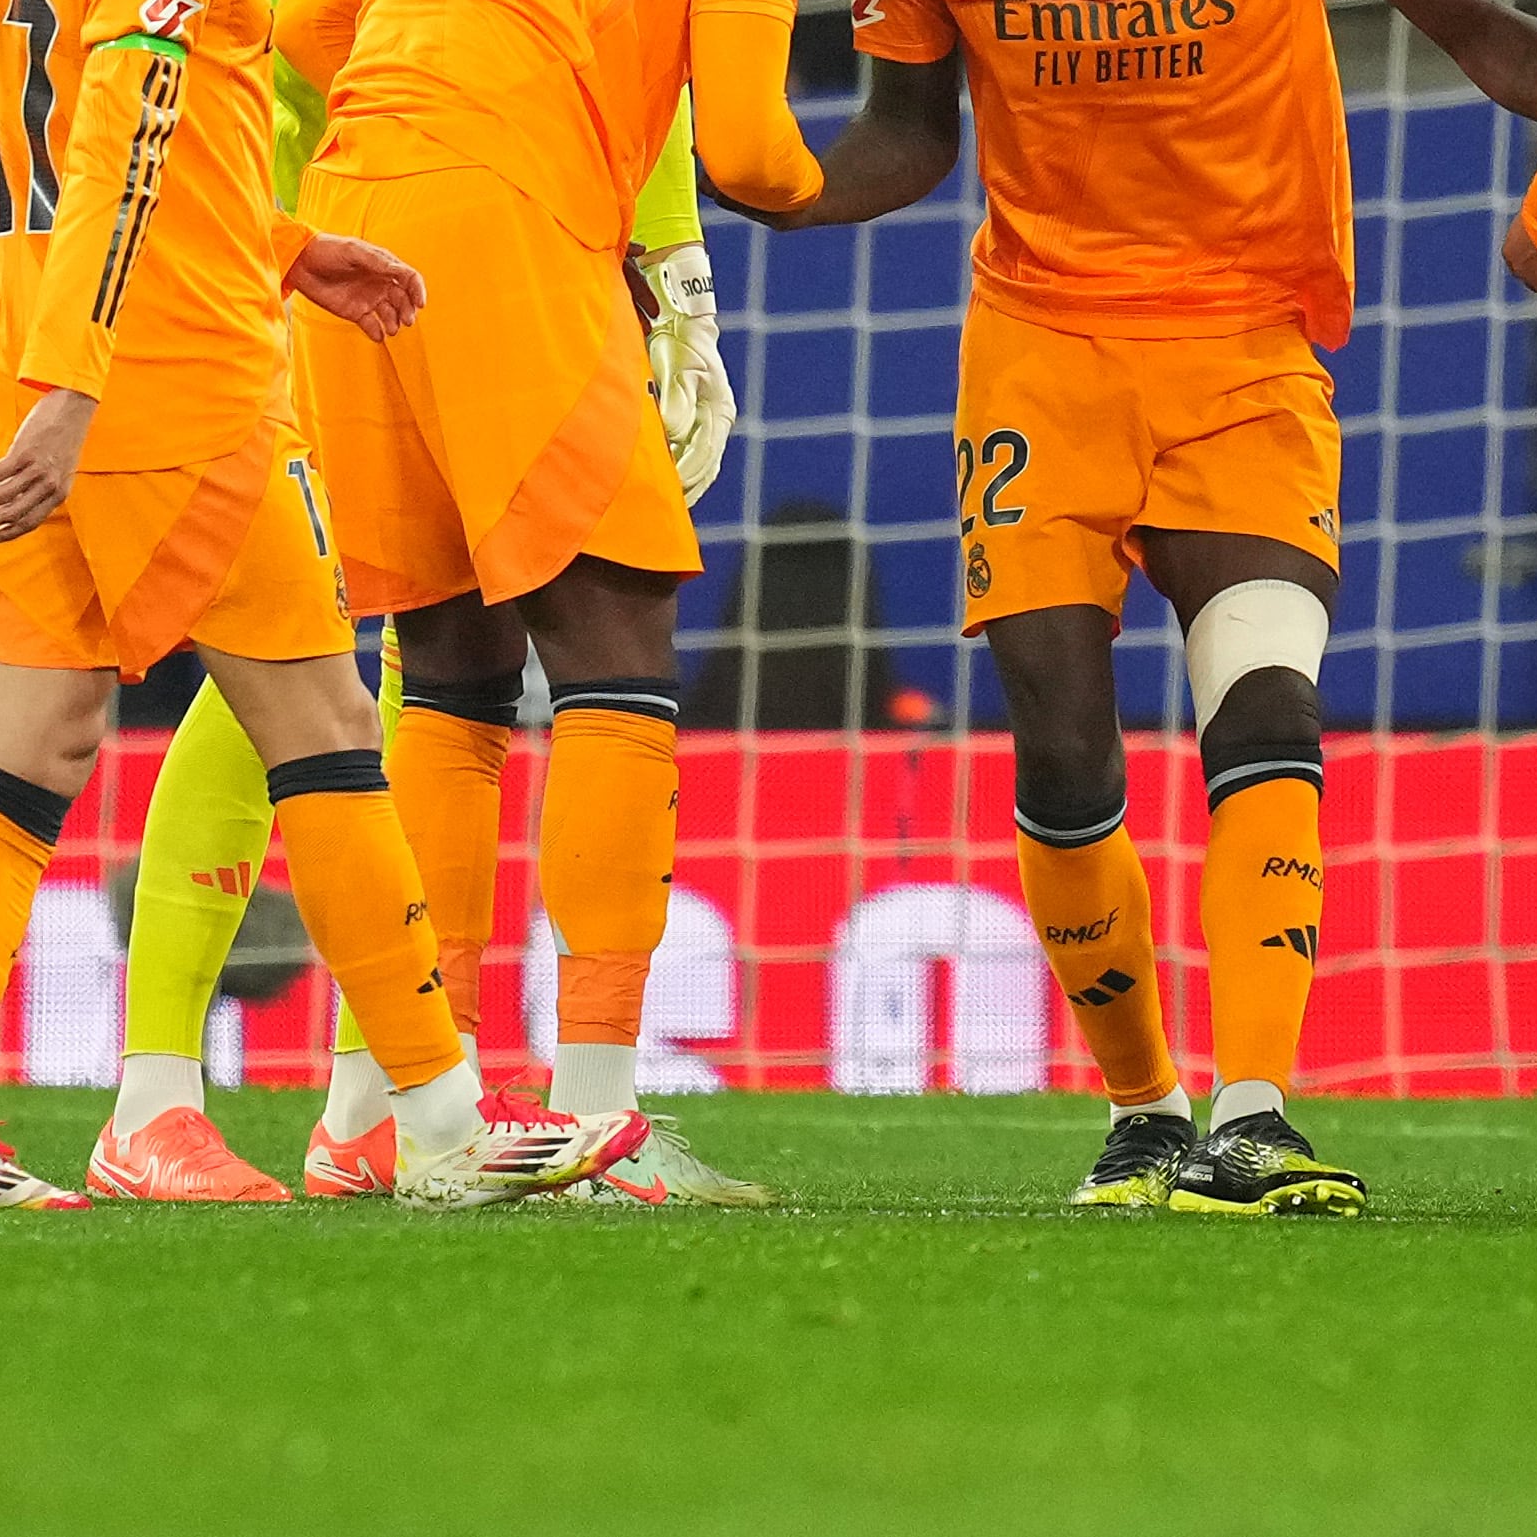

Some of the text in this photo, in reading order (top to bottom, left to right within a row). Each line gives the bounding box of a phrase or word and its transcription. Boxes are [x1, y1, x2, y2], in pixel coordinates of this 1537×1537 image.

[1034, 41, 1204, 87] FLY BETTER
[957, 428, 1029, 537] 22
[1045, 907, 1120, 945] RMCF
